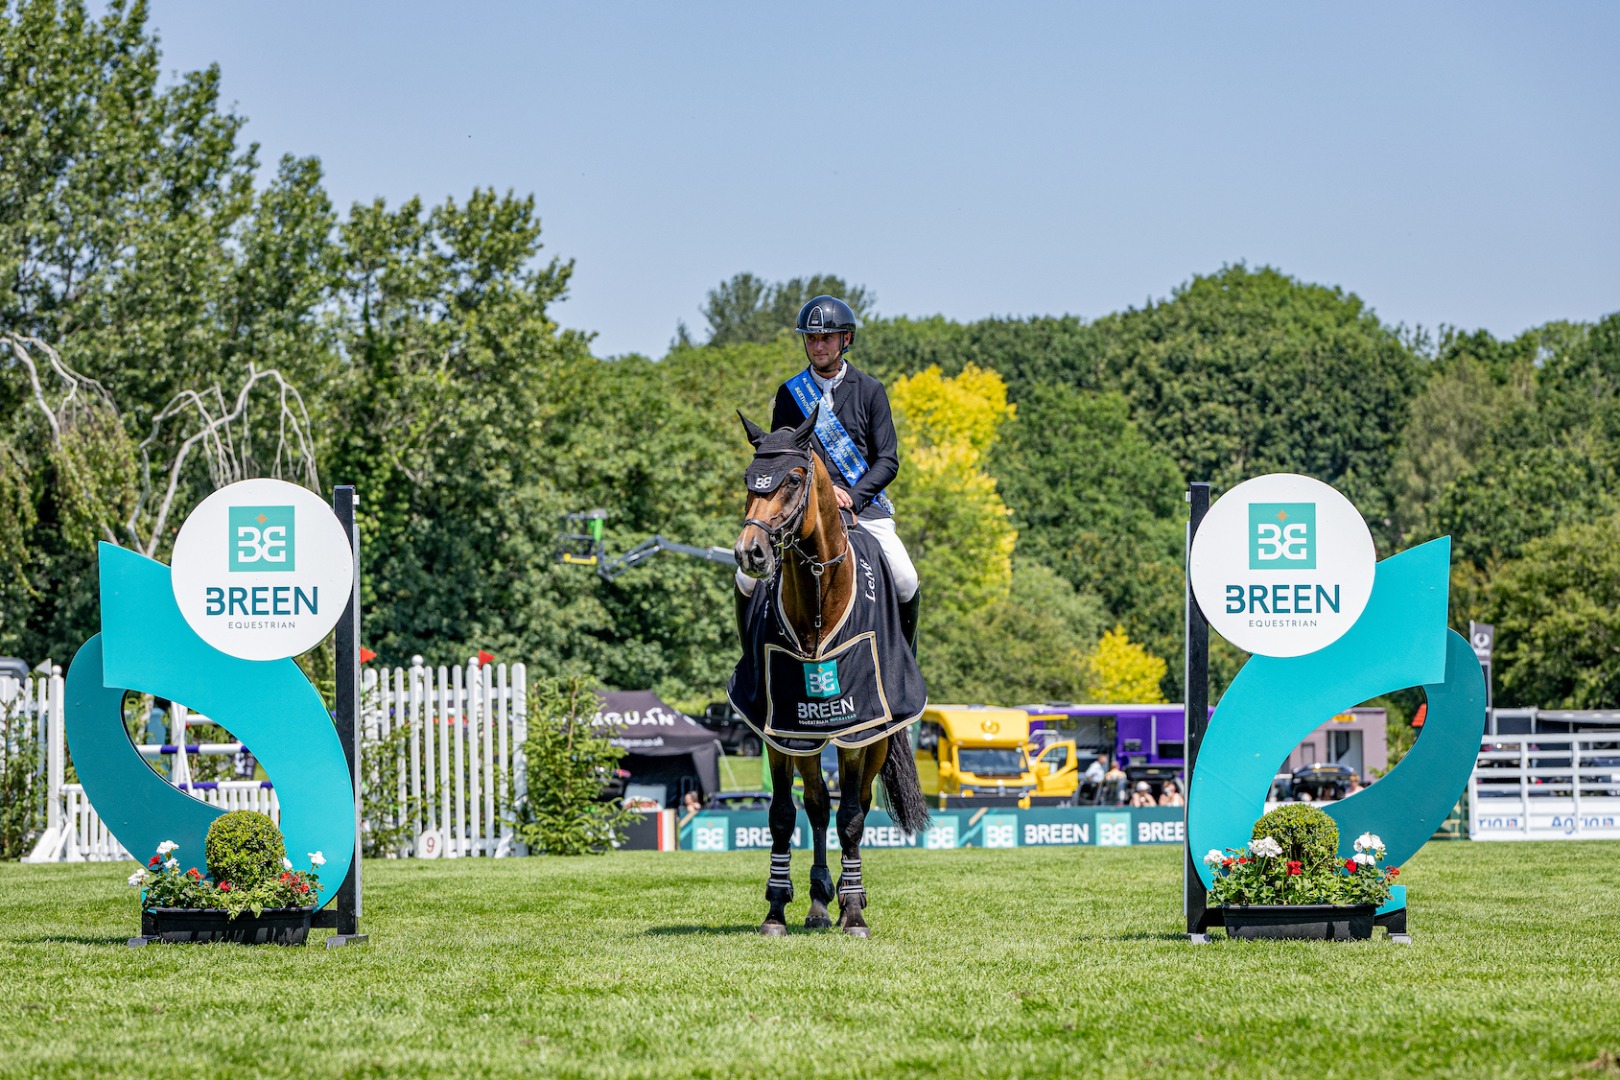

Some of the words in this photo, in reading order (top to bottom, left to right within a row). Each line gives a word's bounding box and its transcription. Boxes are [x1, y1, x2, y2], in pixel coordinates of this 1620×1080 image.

[205, 586, 319, 616] BREEN
[1225, 584, 1341, 615] BREEN
[227, 621, 297, 629] EQUESTRIAN
[1248, 619, 1318, 628] EQUESTRIAN
[797, 696, 855, 719] BREEN
[735, 826, 802, 847] BREN
[858, 826, 917, 847] REEN
[1024, 823, 1090, 844] BREEN
[1137, 821, 1185, 843] BREE
[426, 836, 435, 853] 9
